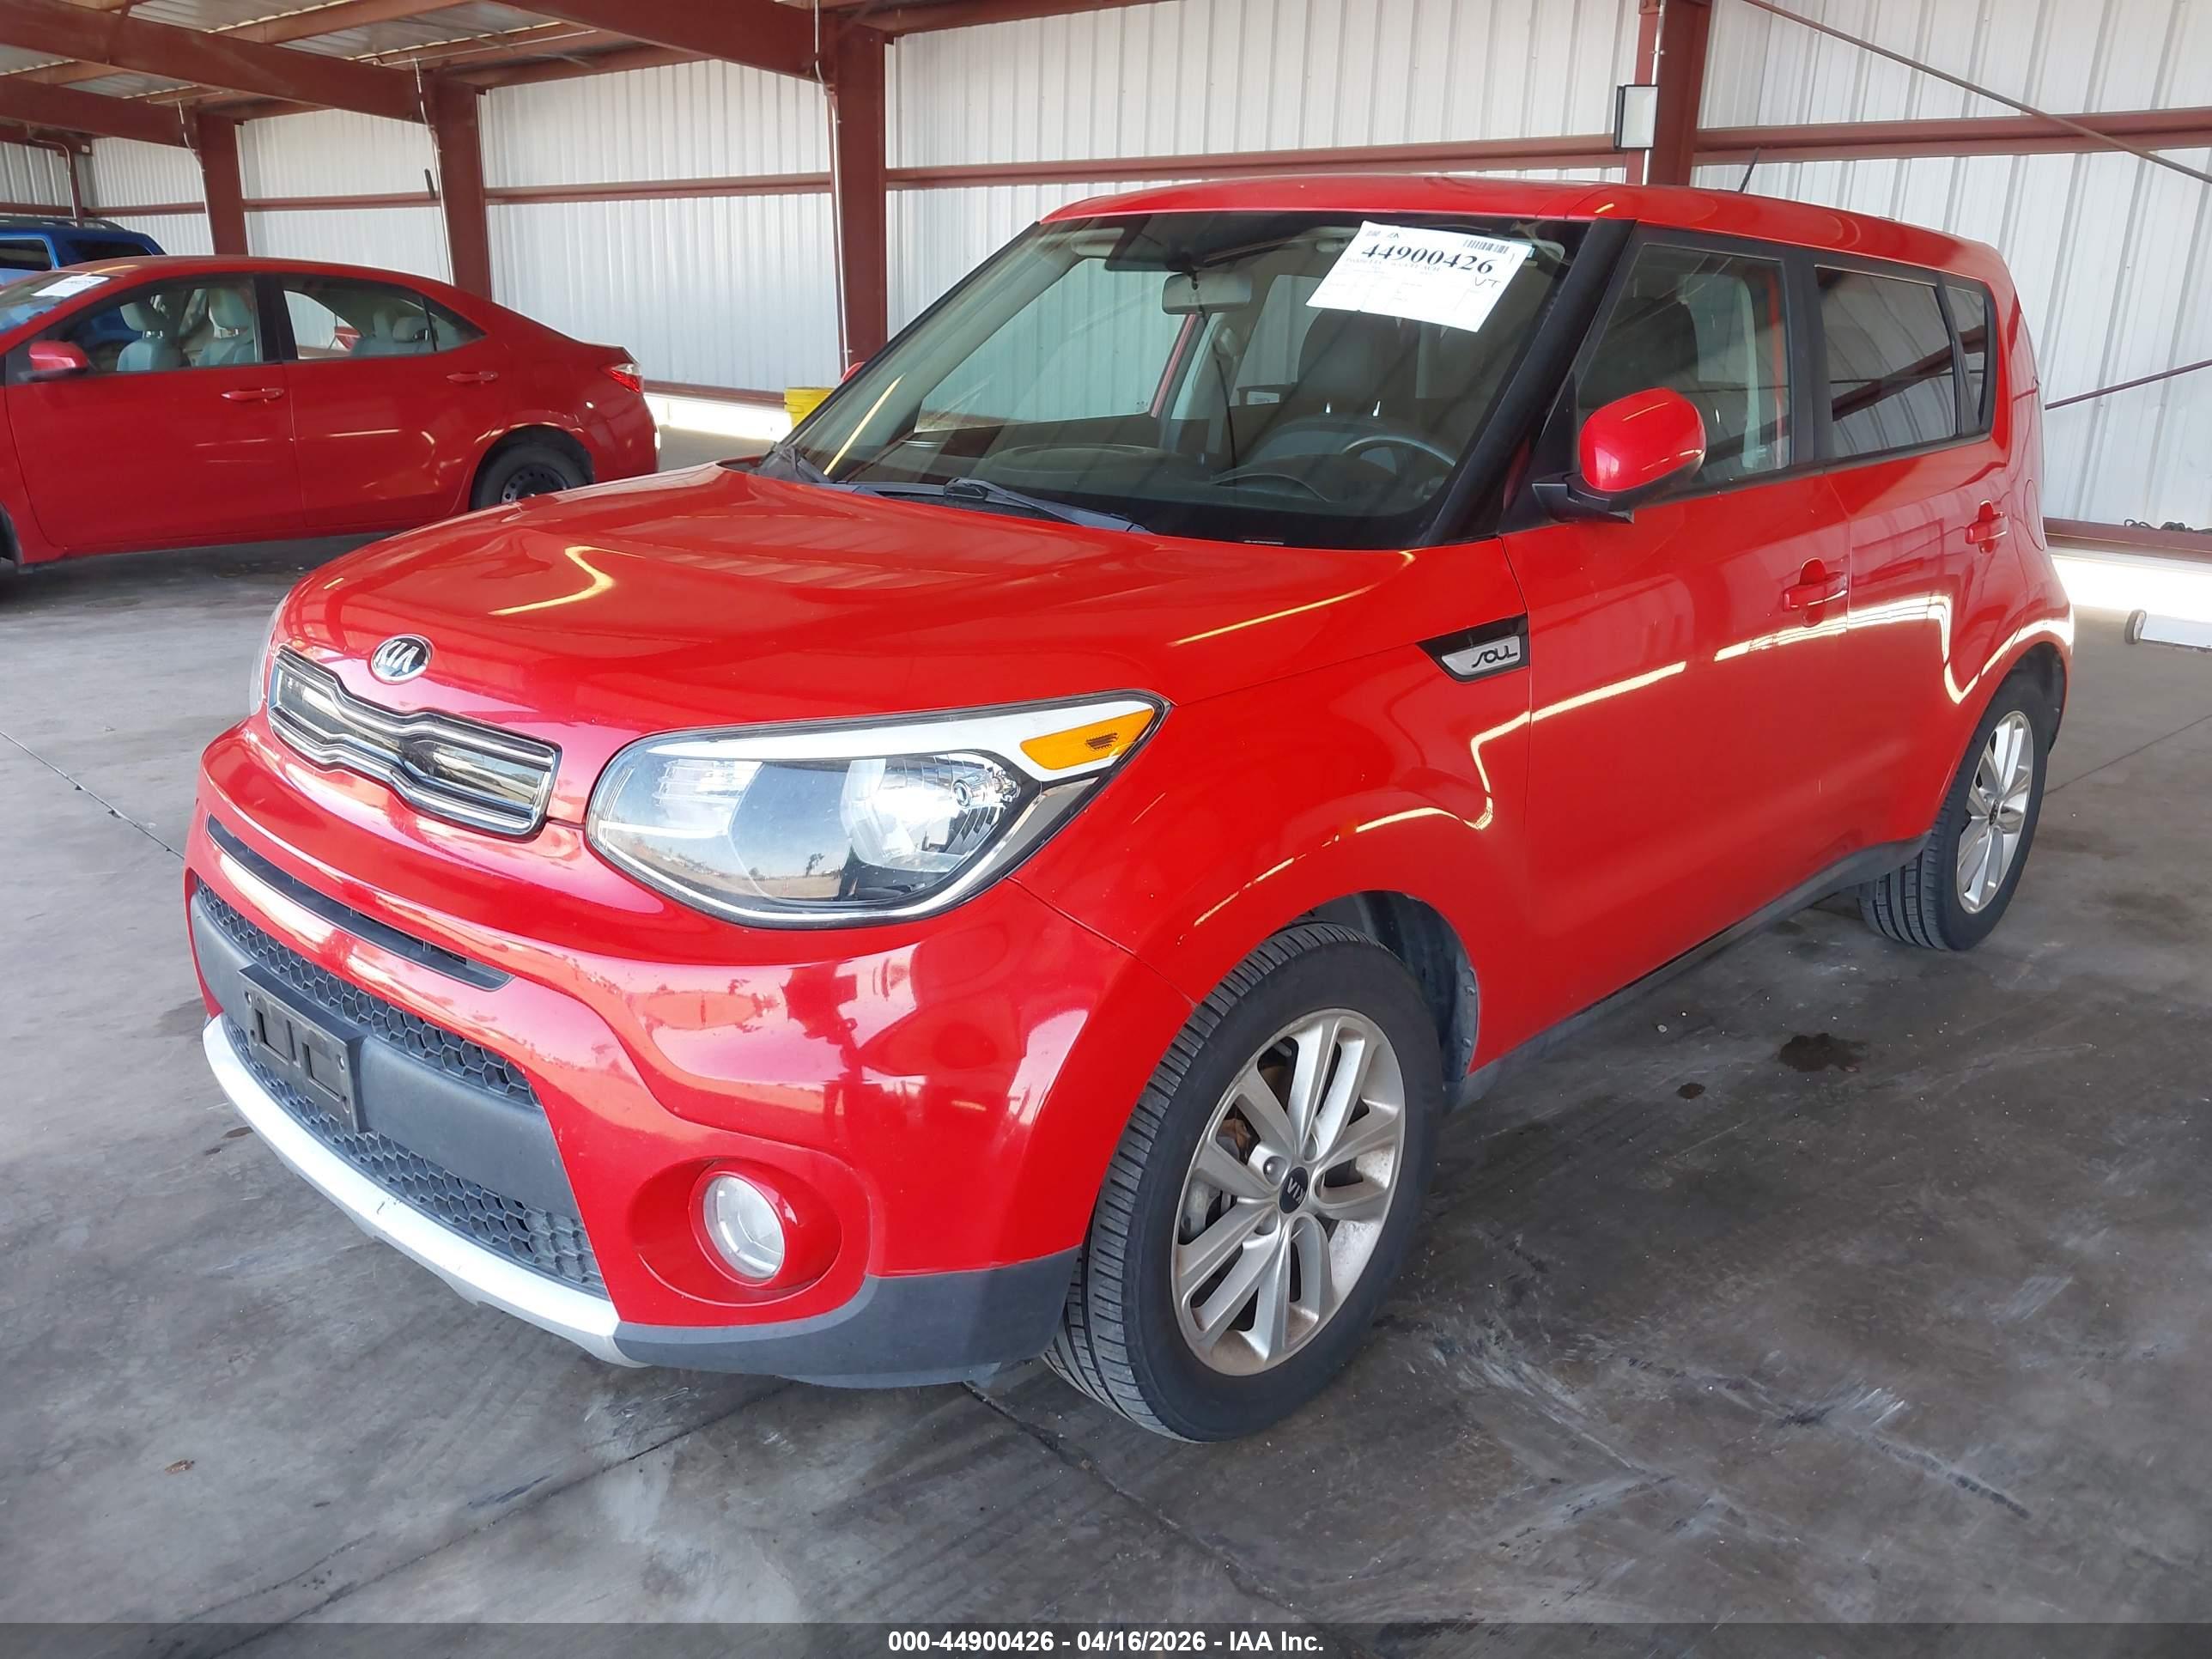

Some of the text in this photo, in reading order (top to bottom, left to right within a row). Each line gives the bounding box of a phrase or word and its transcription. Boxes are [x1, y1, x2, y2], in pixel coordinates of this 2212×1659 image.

[1362, 243, 1498, 274] 44900426
[374, 640, 420, 673] KIA
[1471, 645, 1518, 668] SOUL
[1287, 1176, 1306, 1204] KIA
